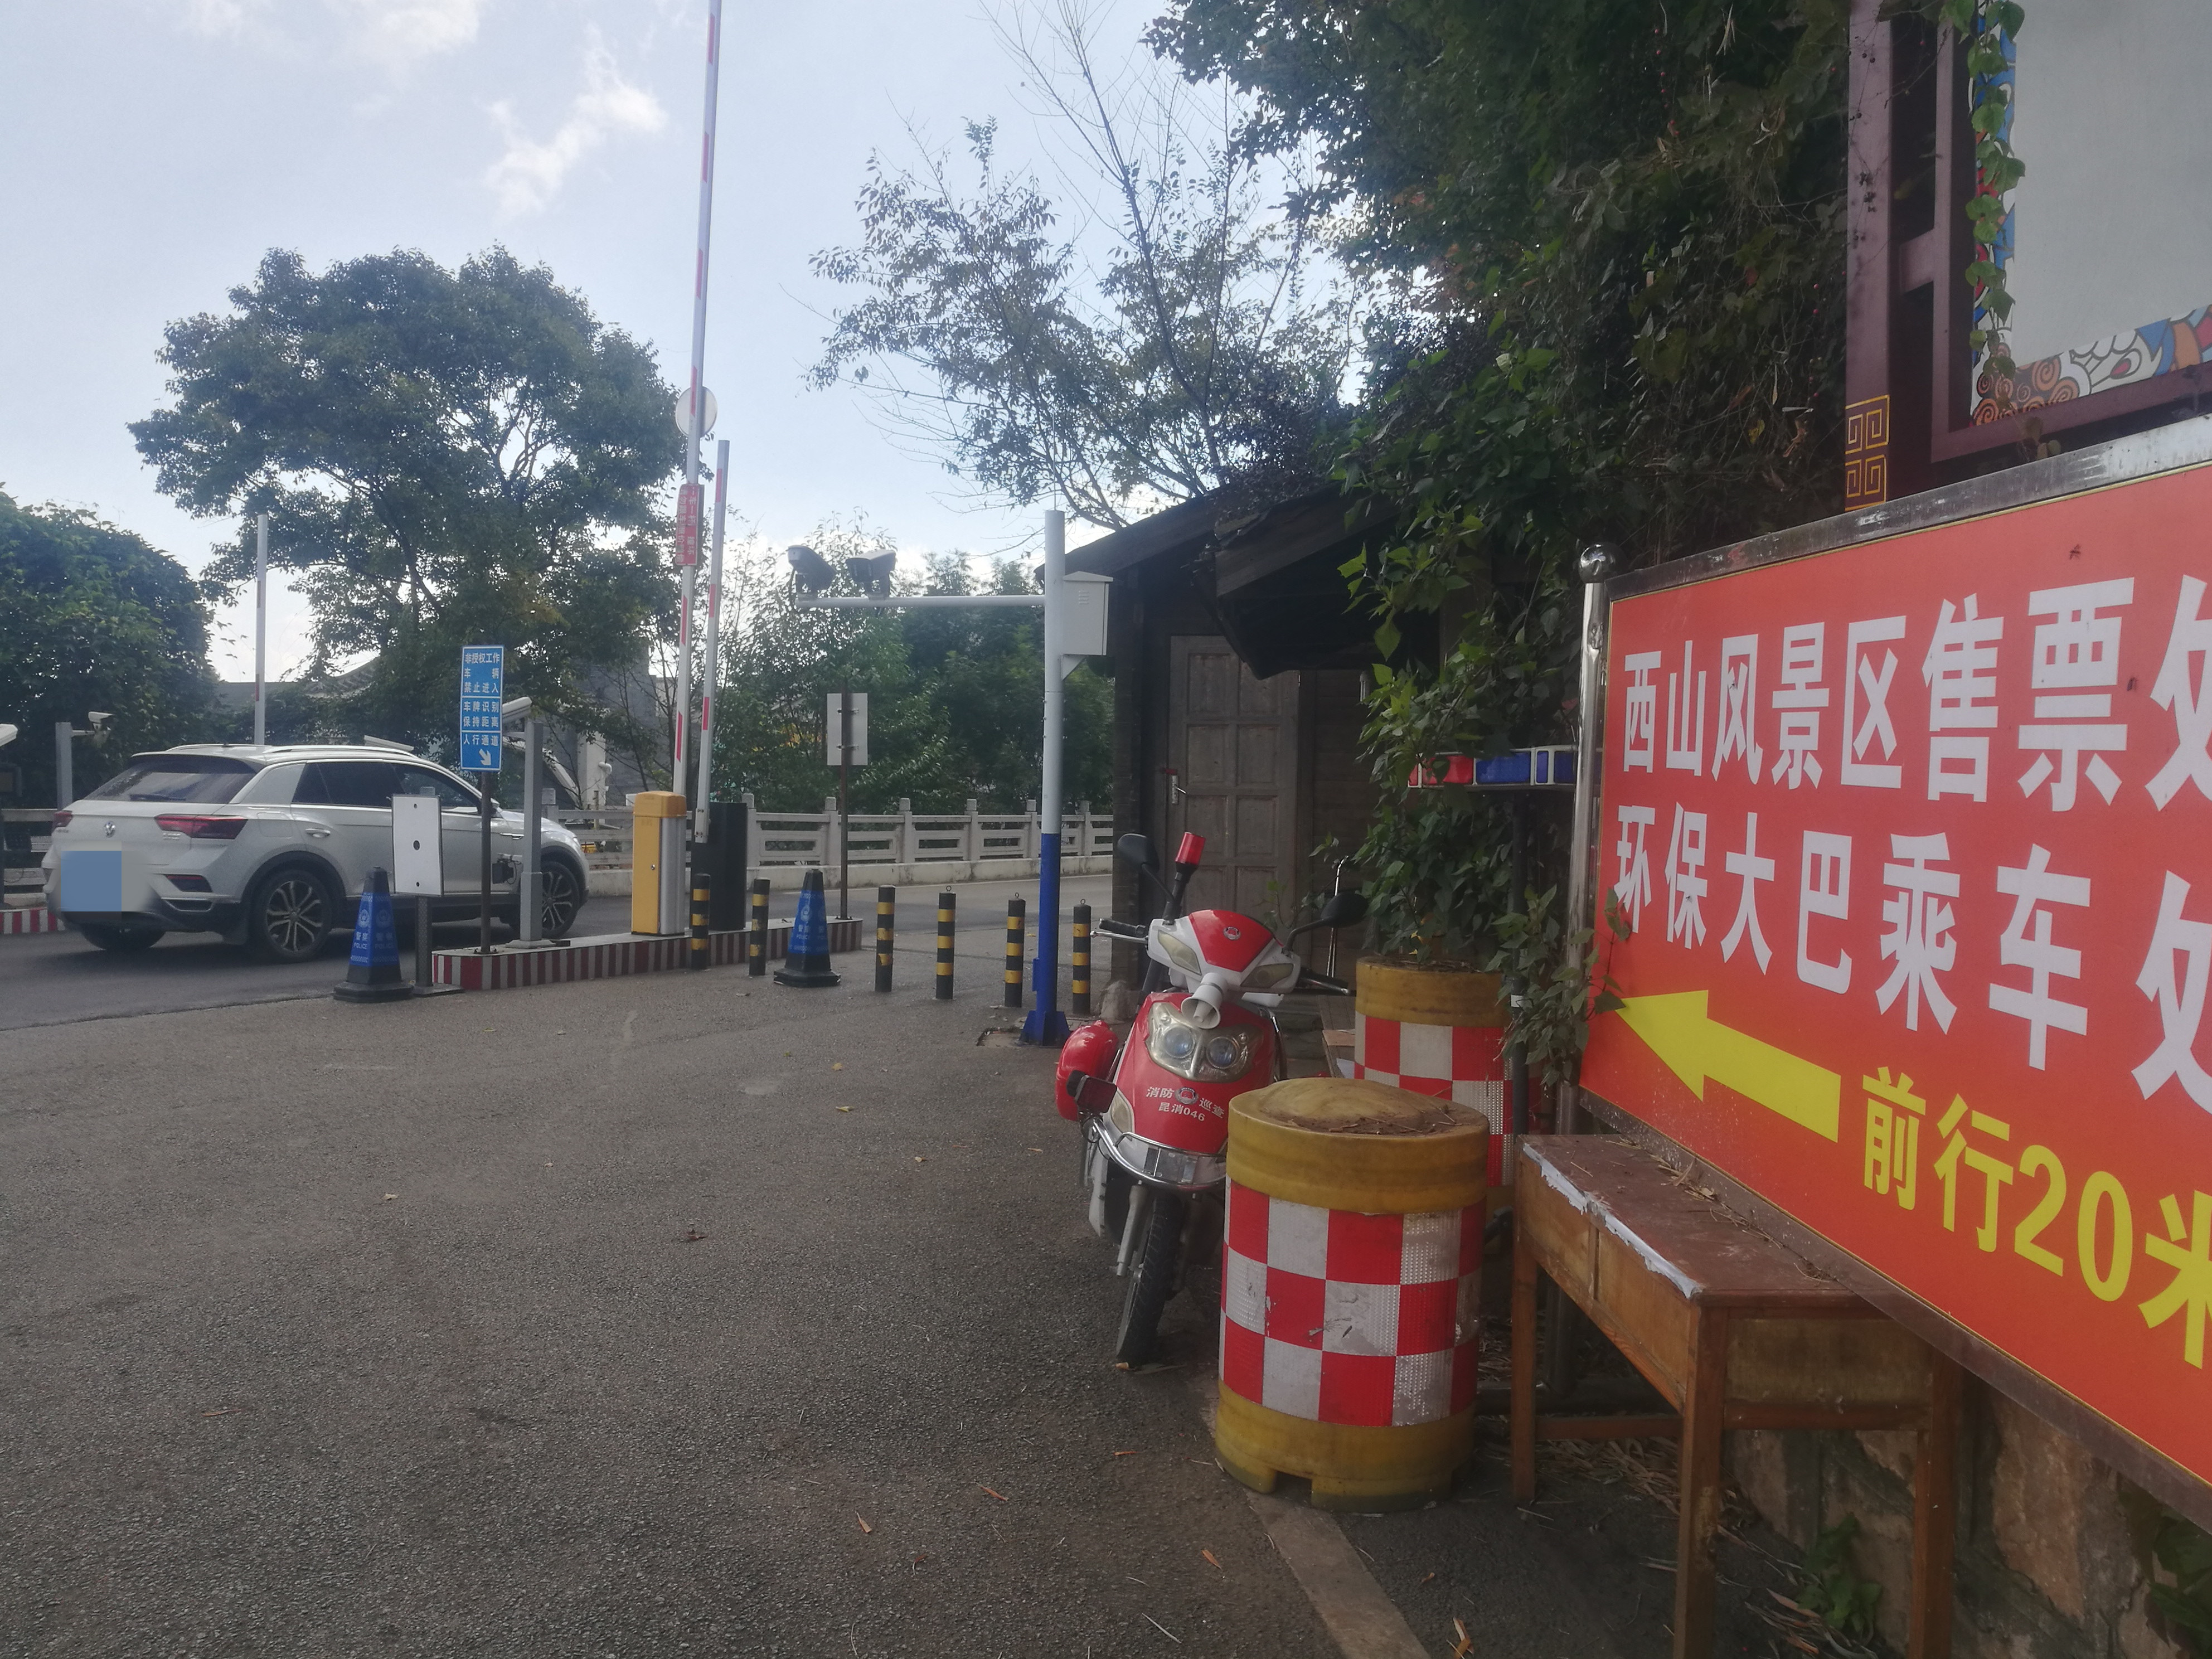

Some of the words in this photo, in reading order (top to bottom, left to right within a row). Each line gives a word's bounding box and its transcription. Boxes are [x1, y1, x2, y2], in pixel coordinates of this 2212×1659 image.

[465, 652, 500, 664] 非授权工作
[464, 682, 499, 693] 禁止进入
[463, 701, 499, 712] 车牌识别
[463, 716, 499, 727] 保持距离
[463, 734, 498, 746] 人行通道
[1612, 803, 2212, 1114] 环保大巴乘车处
[1146, 1086, 1175, 1098] 消防
[1199, 1098, 1225, 1118] 巡查
[1158, 1102, 1205, 1122] 昆消046
[1861, 1066, 2212, 1369] 前行20米
